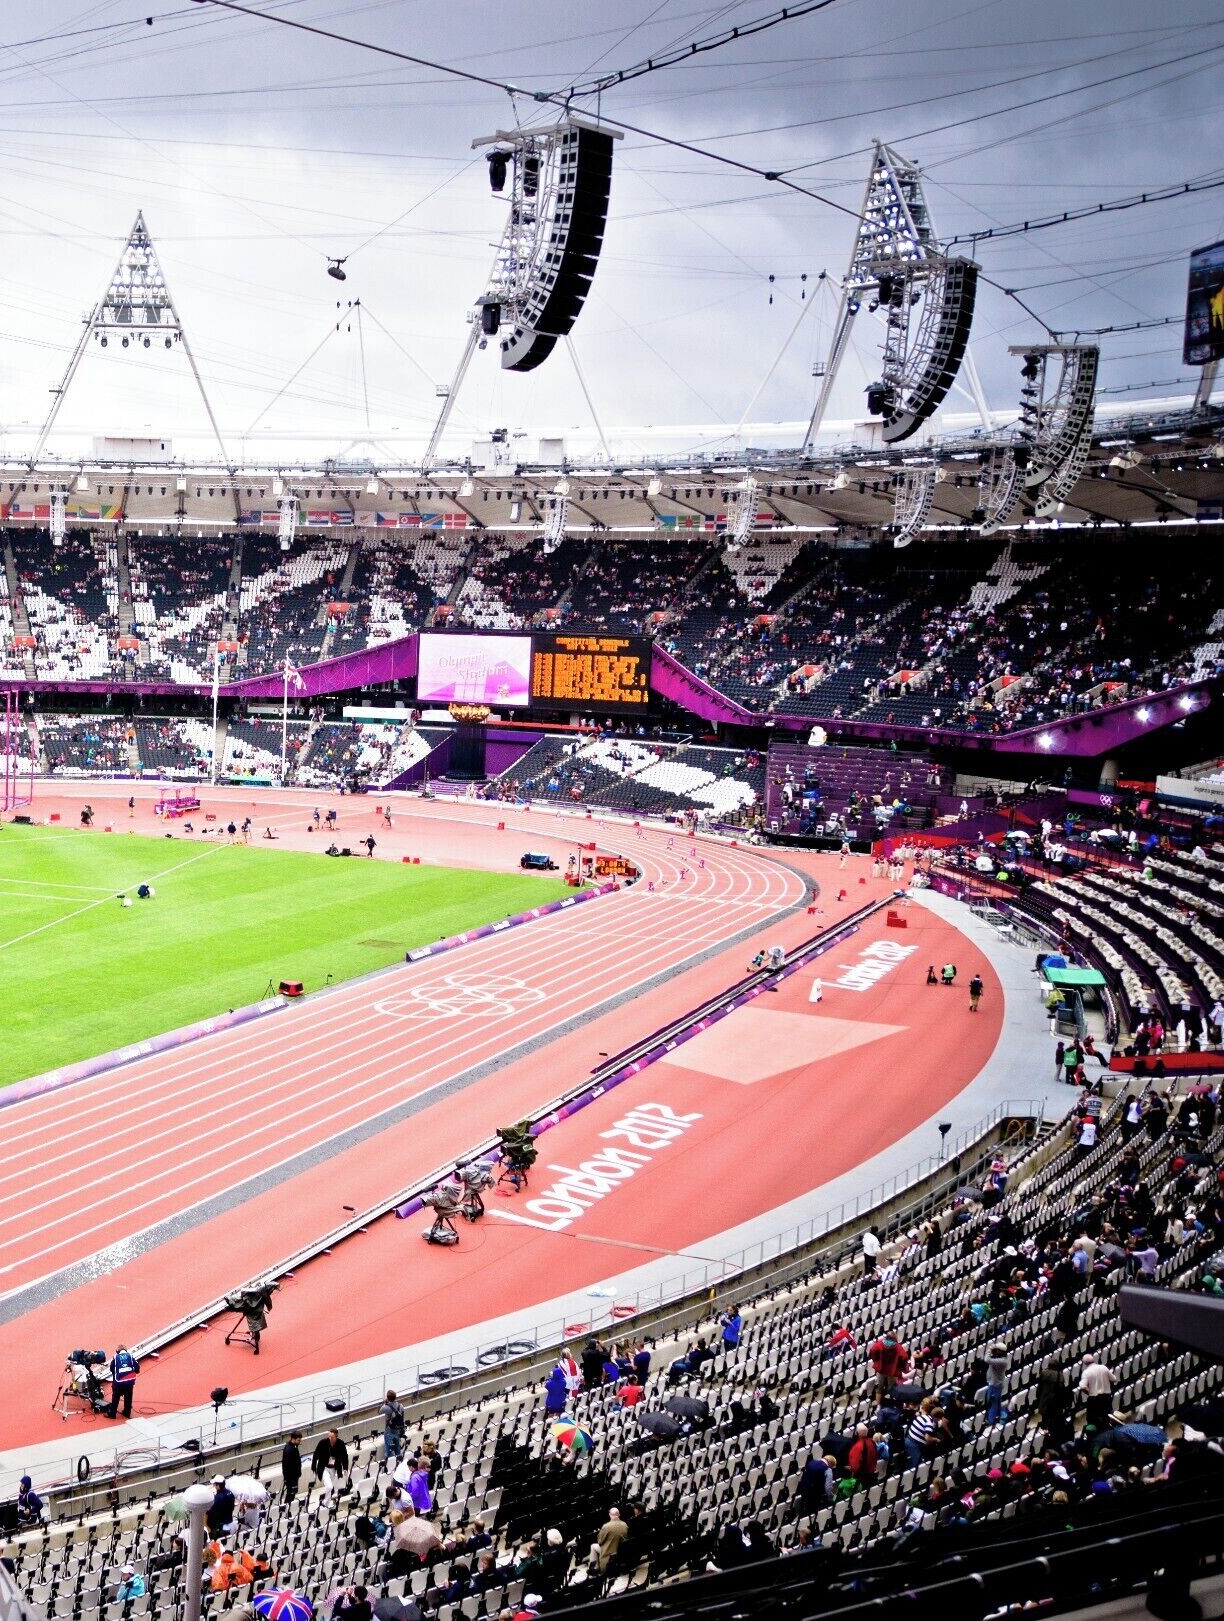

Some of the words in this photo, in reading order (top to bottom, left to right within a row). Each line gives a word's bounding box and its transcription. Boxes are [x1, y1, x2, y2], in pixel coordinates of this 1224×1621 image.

[439, 650, 487, 669] Olympic
[456, 664, 510, 680] Stadium
[487, 1147, 653, 1232] London
[598, 1102, 705, 1150] 2012
